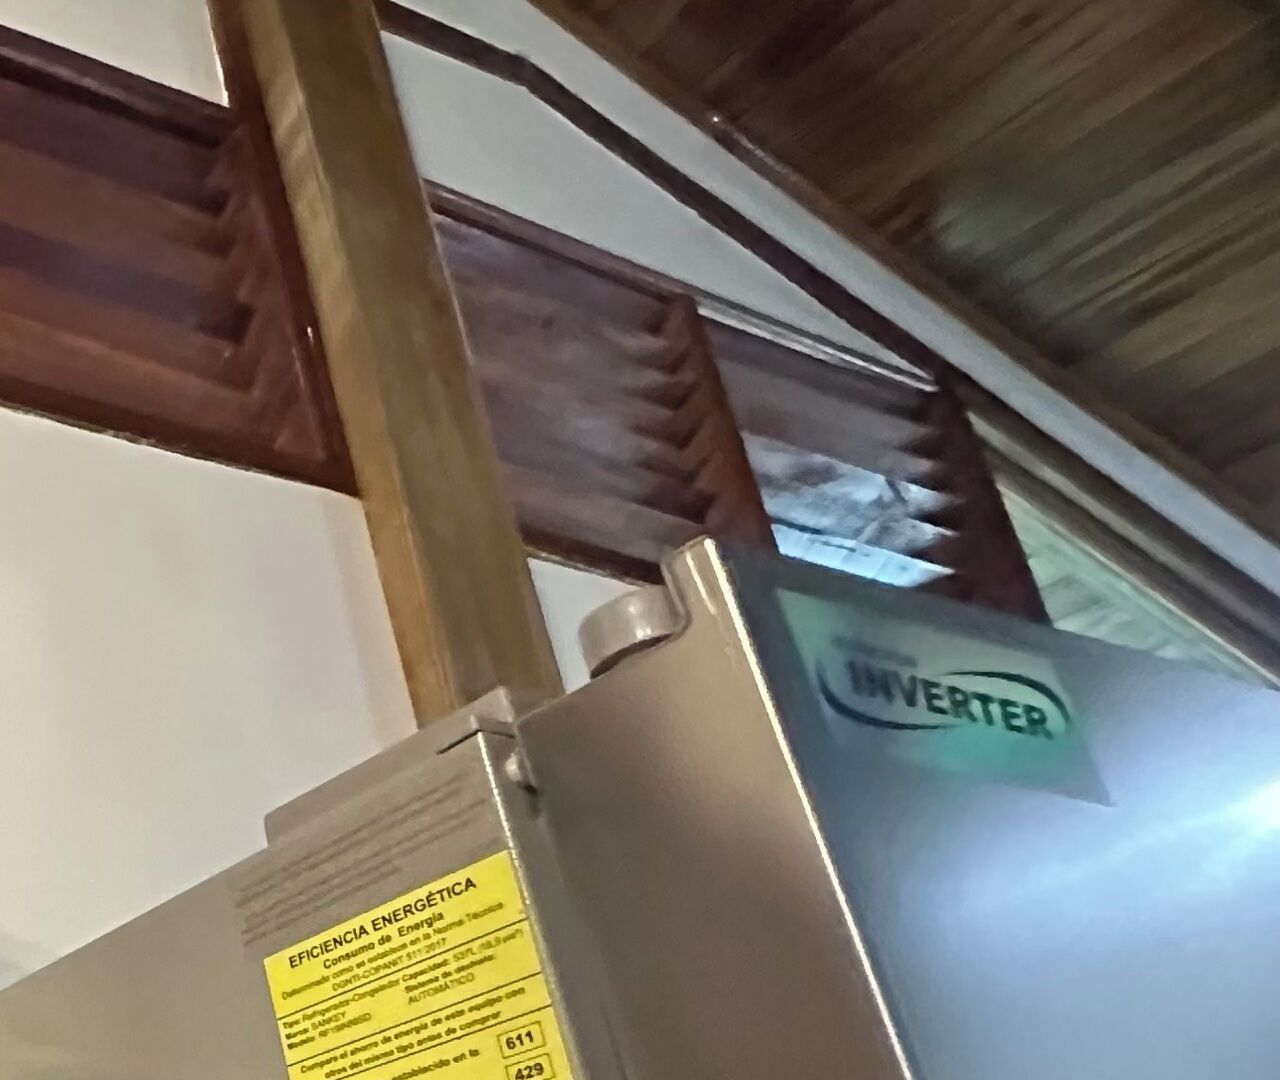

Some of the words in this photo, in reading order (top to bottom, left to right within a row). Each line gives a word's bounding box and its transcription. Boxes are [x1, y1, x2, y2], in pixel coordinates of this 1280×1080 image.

[846, 657, 1055, 740] INVERTER
[288, 925, 370, 969] EFICIENCIA
[371, 877, 476, 931] ENERGÉTICA
[323, 942, 375, 969] Consumo
[378, 934, 392, 946] de
[397, 911, 444, 937] Energía
[432, 919, 464, 935] Norma
[505, 1030, 534, 1050] 611
[514, 1062, 545, 1080] 429
